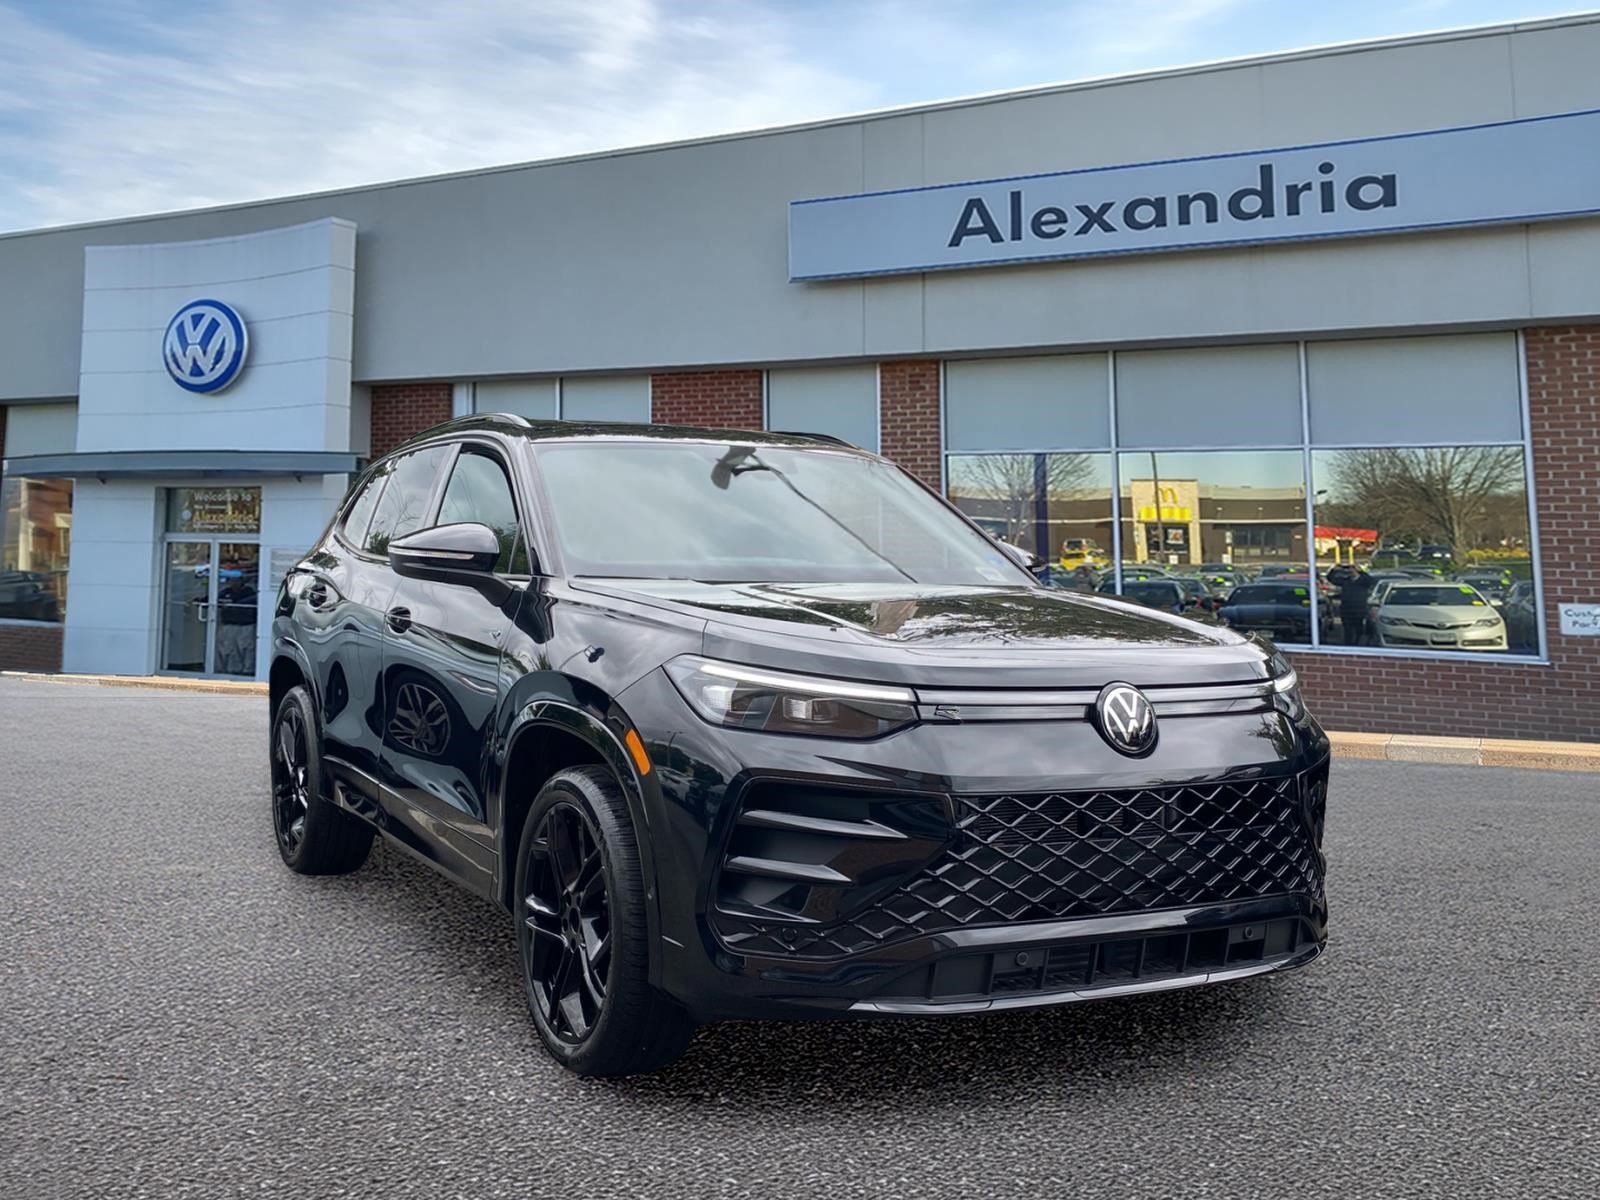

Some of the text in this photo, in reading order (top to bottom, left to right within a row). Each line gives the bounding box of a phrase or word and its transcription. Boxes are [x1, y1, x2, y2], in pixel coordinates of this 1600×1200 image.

[947, 162, 1398, 247] Alexandria
[165, 303, 240, 388] VW
[194, 491, 252, 501] Welcome to
[1101, 684, 1155, 752] VW
